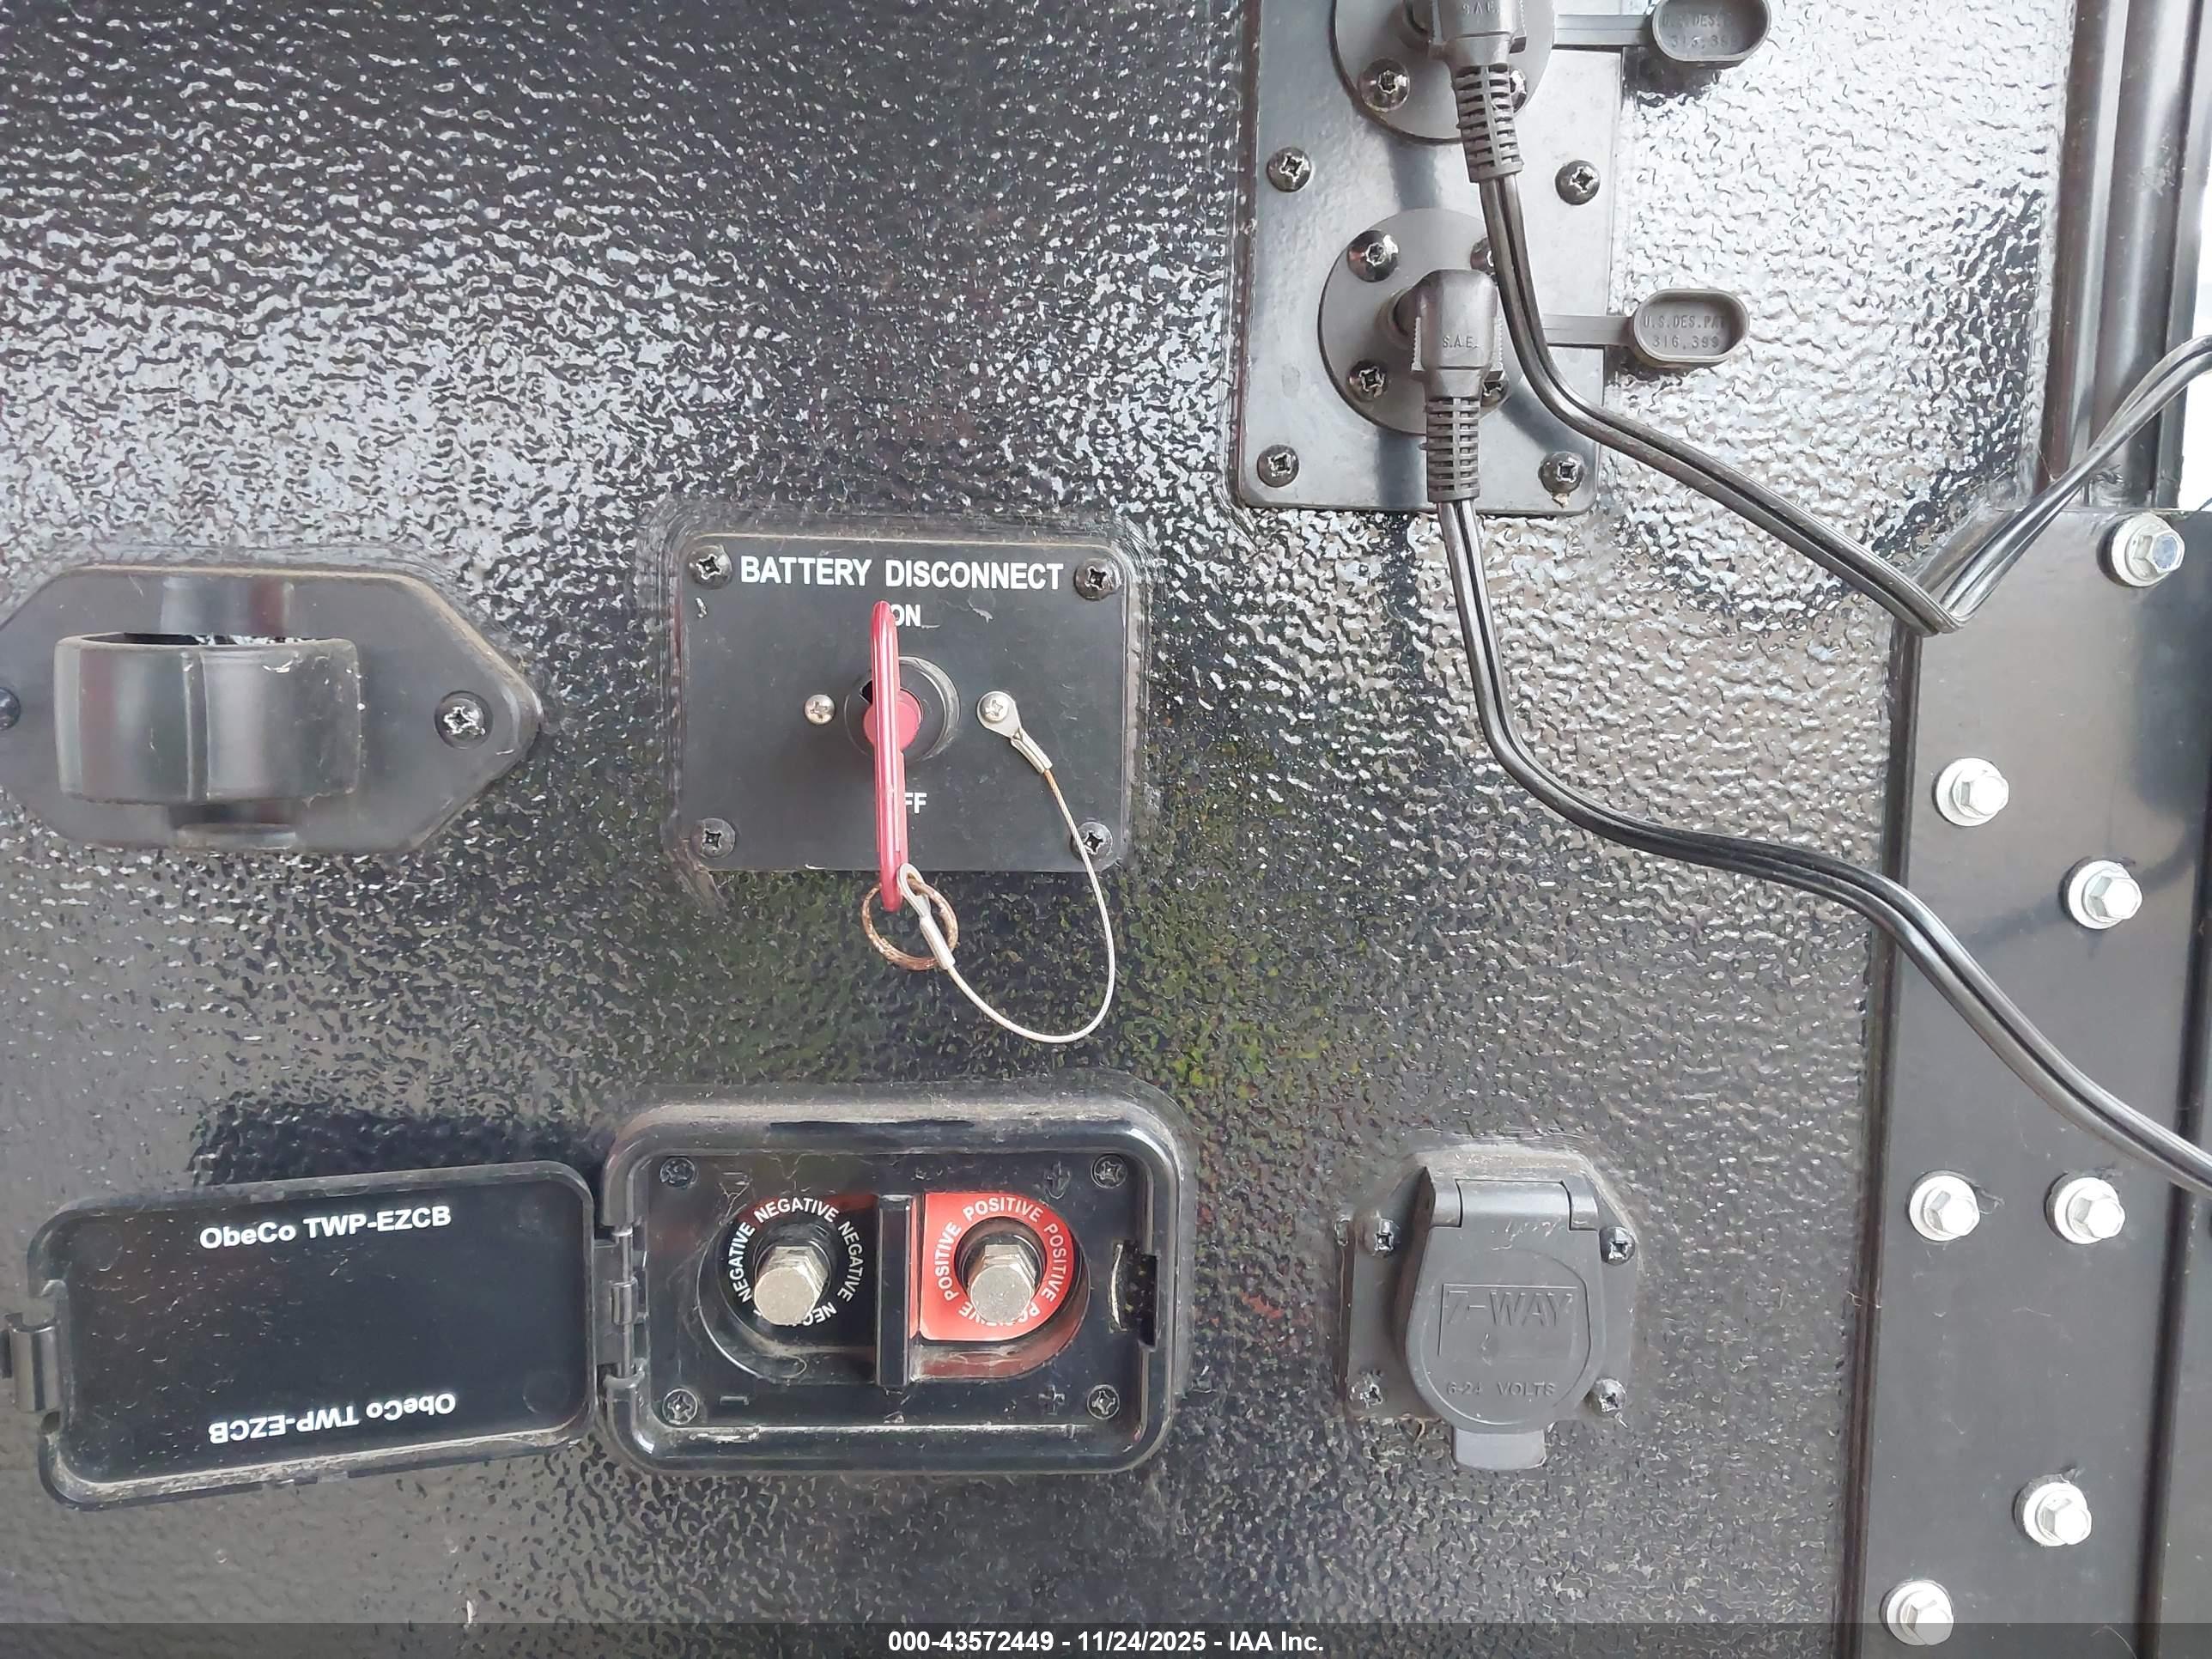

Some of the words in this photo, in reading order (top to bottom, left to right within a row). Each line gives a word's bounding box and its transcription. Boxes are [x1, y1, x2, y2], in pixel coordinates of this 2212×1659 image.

[740, 556, 872, 586] BATTERY
[885, 560, 1064, 590] DISCONNECT
[890, 604, 921, 627] ON
[904, 792, 927, 813] FF
[199, 1220, 296, 1250] ObeCo
[303, 1205, 453, 1238] TWP-EZCB
[753, 1196, 840, 1224] NEGATIVE
[962, 1196, 1043, 1224] POSITIVE
[727, 1221, 756, 1304] NEGATIVE
[837, 1220, 864, 1303] NEGATIVE
[933, 1221, 962, 1302] POSITIVE
[1043, 1222, 1067, 1303] POSITIVE
[1447, 1290, 1573, 1326] 7-WAY
[1496, 1381, 1556, 1396] VOLTS
[366, 1392, 457, 1422] ObeCo
[208, 1406, 359, 1444] TWP-EZCB
